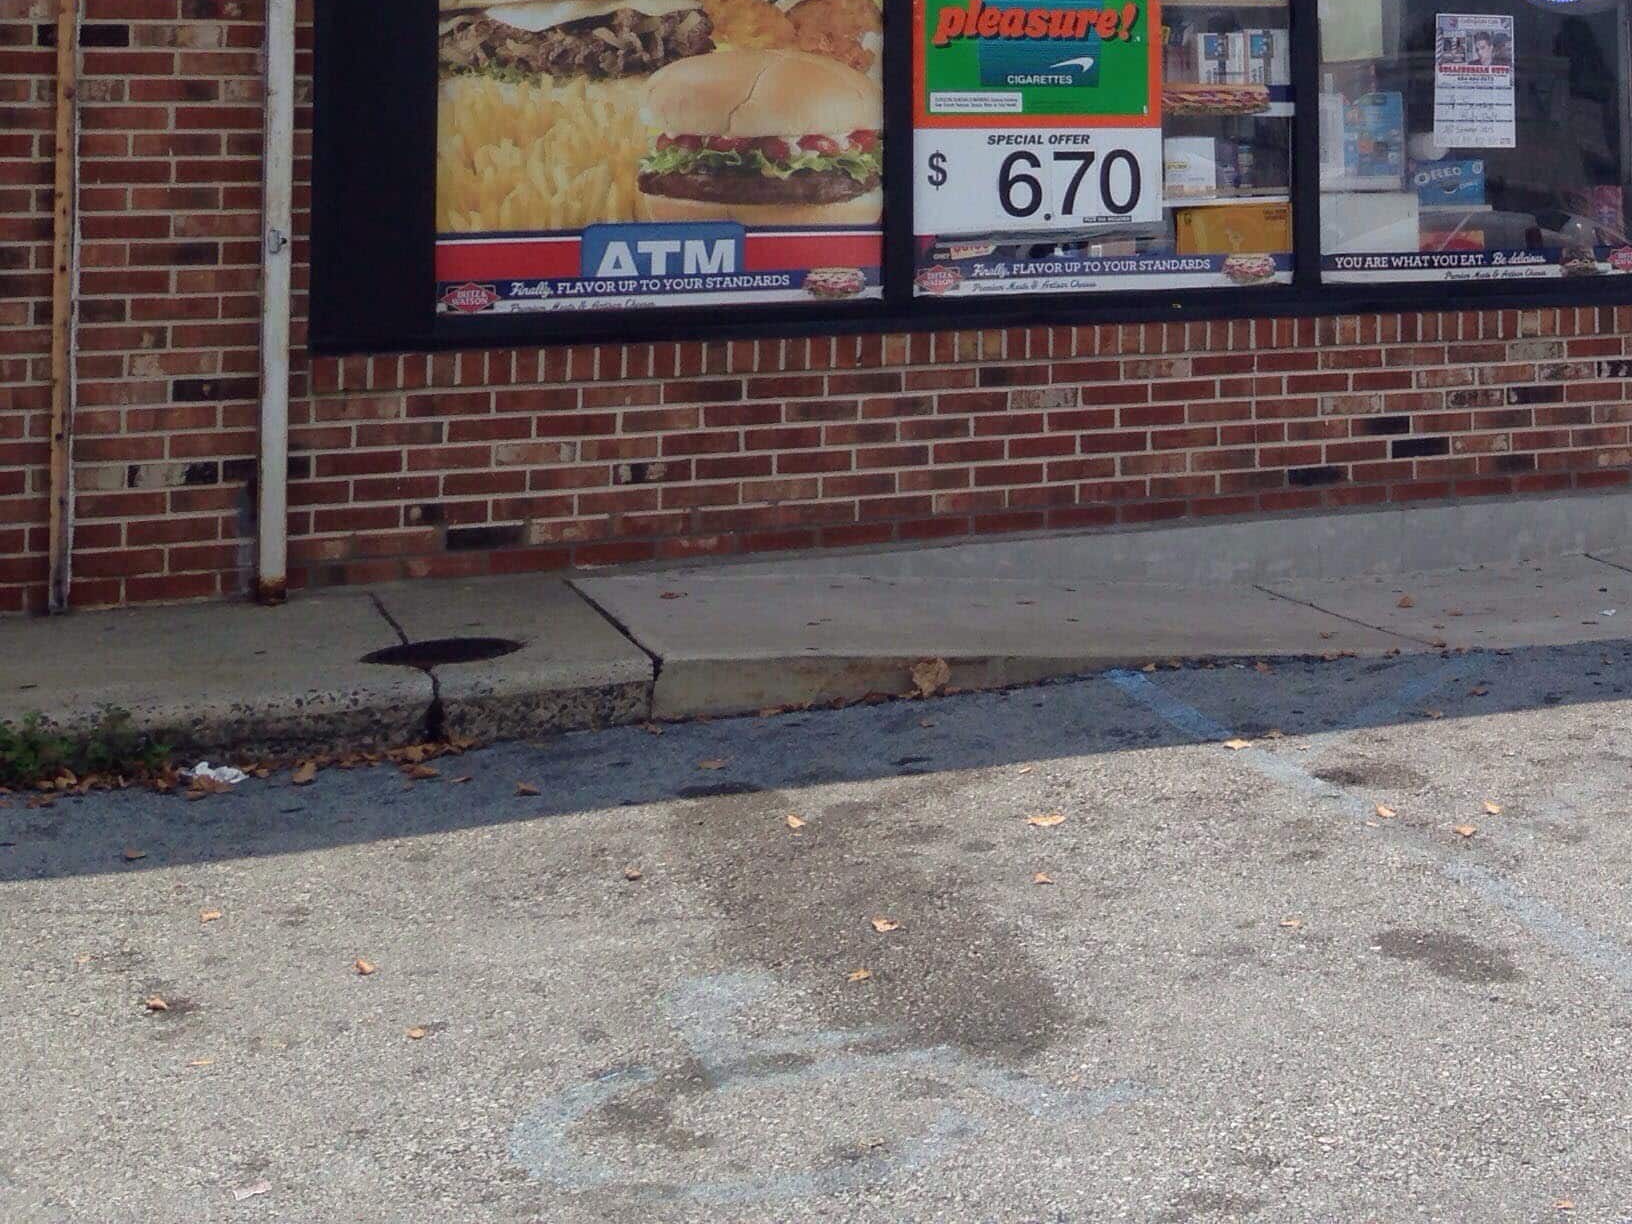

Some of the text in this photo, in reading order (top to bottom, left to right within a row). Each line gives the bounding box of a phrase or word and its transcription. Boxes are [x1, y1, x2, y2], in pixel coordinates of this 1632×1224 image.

[1007, 74, 1073, 86] CIGARETTES
[987, 133, 1091, 146] SPECIAL OFFER
[1414, 165, 1463, 185] OREO
[927, 148, 1142, 222] $ 6.70
[597, 239, 735, 277] ATM
[1012, 262, 1063, 274] FLAVOR
[1065, 261, 1081, 273] UP
[1083, 261, 1101, 272] TO
[1103, 259, 1138, 271] YOUR
[1139, 257, 1211, 270] STANDARDS
[1335, 256, 1362, 269] YOU
[1364, 256, 1388, 269] ARE
[1390, 255, 1430, 268] WHAT
[1431, 255, 1458, 267] YOU
[1492, 252, 1508, 265] Be
[557, 280, 616, 295] FLAVOR
[618, 279, 638, 293] UP
[639, 278, 661, 291] TO
[663, 277, 703, 291] YOUR
[705, 274, 791, 288] STANDARDS
